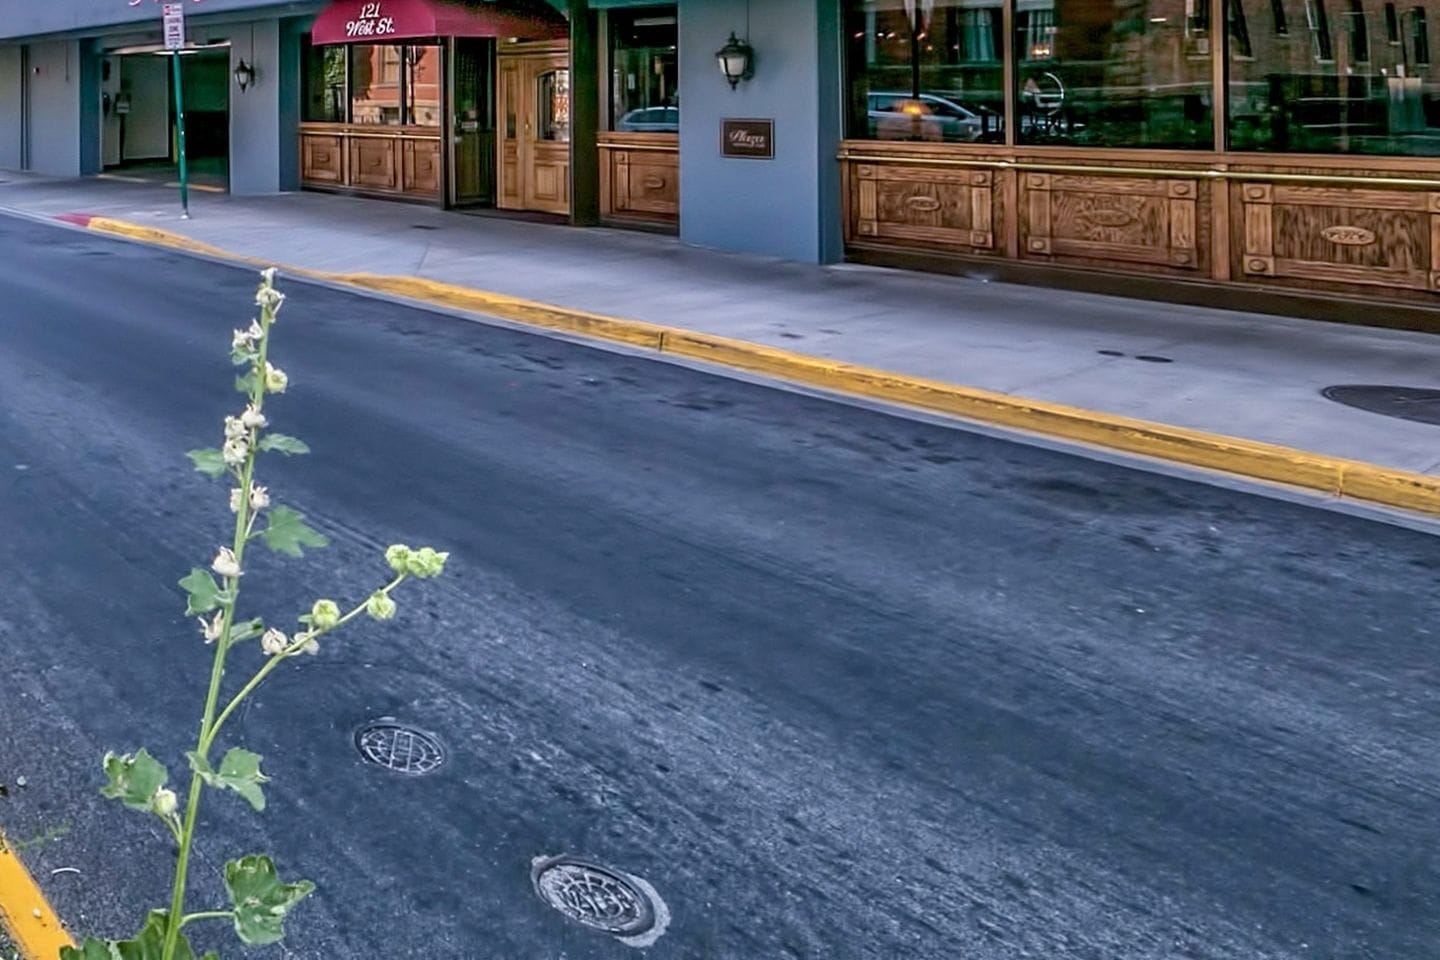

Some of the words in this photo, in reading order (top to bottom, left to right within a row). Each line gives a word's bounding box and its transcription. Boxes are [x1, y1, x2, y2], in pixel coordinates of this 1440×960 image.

[359, 2, 381, 19] 121
[346, 19, 375, 37] West
[376, 17, 395, 35] St.
